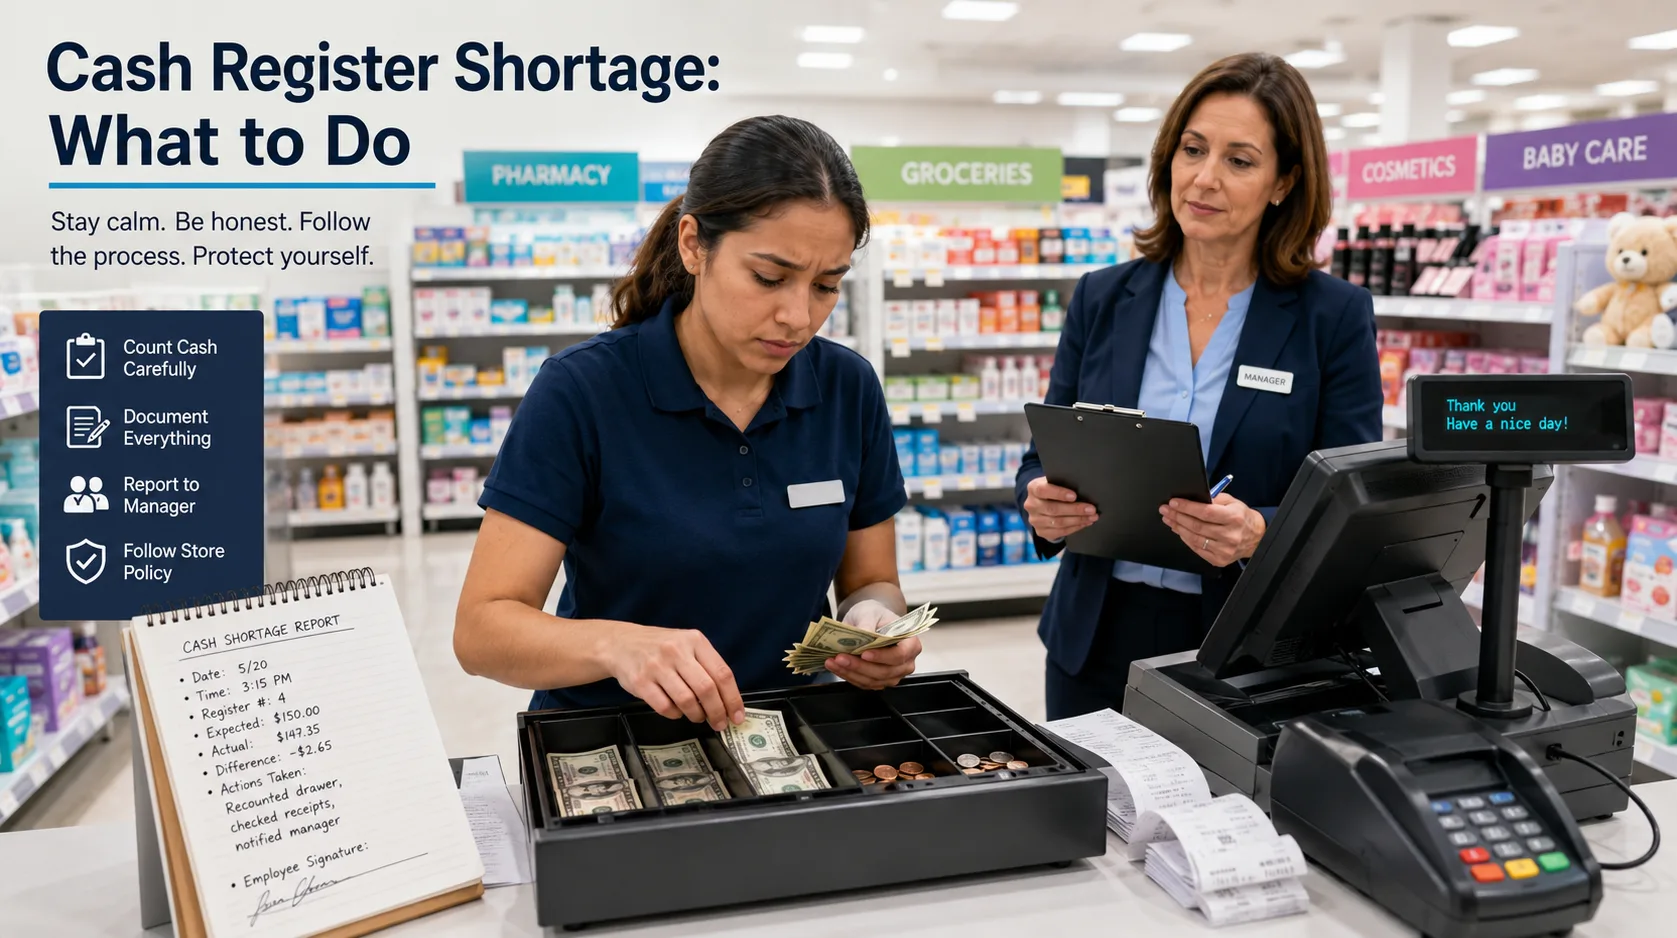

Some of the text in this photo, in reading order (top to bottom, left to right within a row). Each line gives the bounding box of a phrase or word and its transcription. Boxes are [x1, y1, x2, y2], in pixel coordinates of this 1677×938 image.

[1522, 135, 1648, 170] BABY CARE
[492, 164, 611, 186] PHARMACY
[901, 161, 1034, 186] GROCERIES
[1361, 155, 1456, 184] COSMETICS
[1244, 373, 1286, 386] MANAGER
[1447, 399, 1516, 414] Thank you
[1447, 417, 1567, 431] Have a nice day!
[183, 614, 340, 653] CASH SHORTAGE REPORT
[192, 660, 267, 683] Date: 5/20
[196, 673, 292, 701] Time: 3:15 PM
[202, 692, 285, 721] Register #: 4
[207, 706, 320, 739] Expected: $150.00
[212, 724, 320, 757] Actual: $147.35
[216, 754, 280, 776] Difference:
[221, 768, 306, 796] Actions Taken:
[226, 779, 342, 814] Recounted drawer,
[231, 800, 334, 832] checked receipts,
[236, 817, 340, 851] notified manager
[244, 842, 368, 888] Employee Signature:
